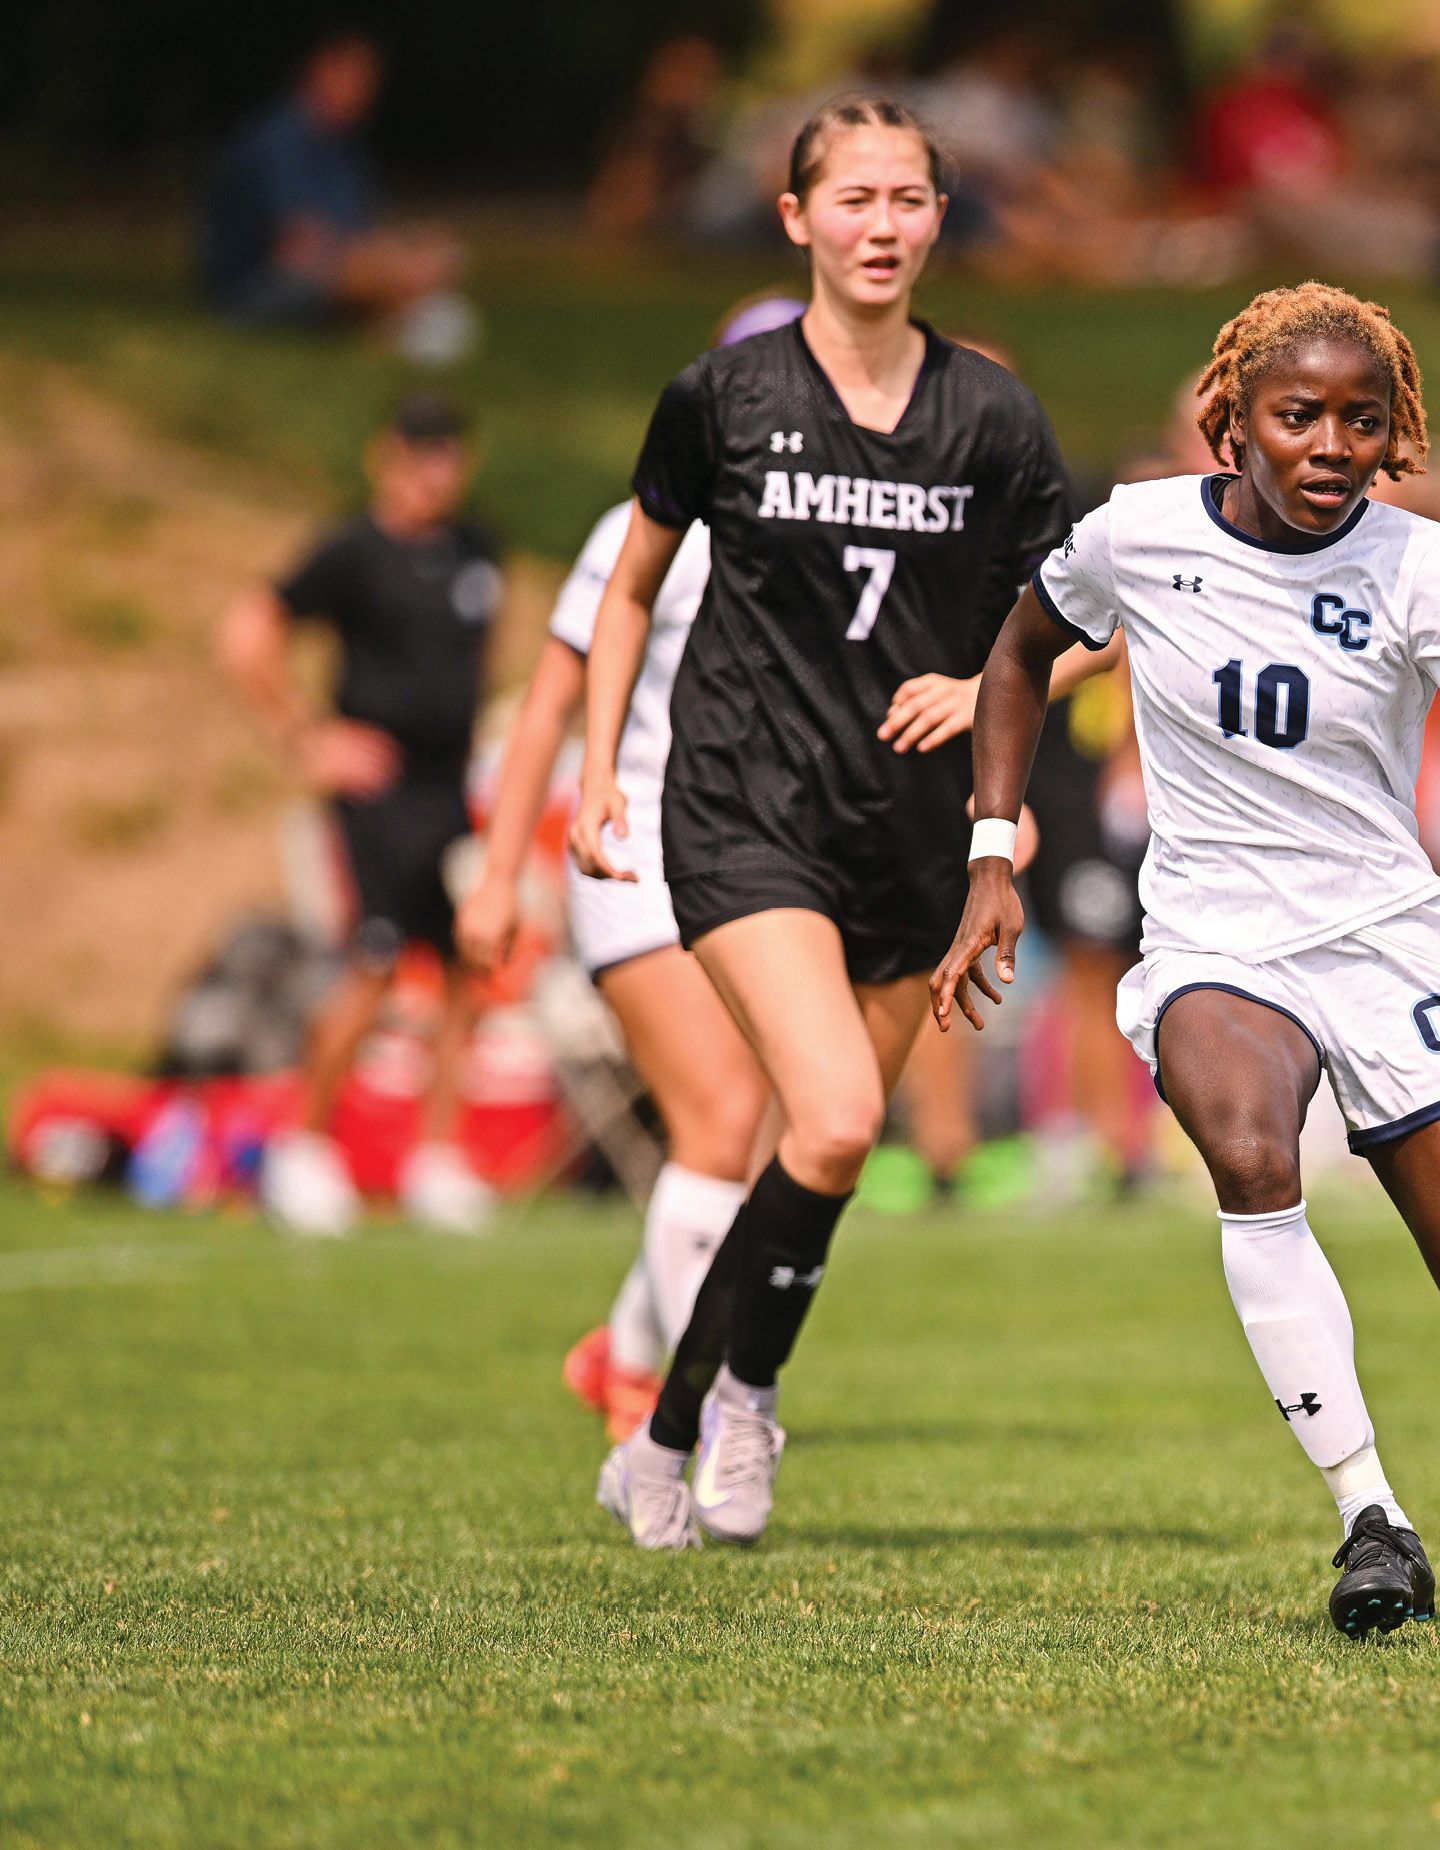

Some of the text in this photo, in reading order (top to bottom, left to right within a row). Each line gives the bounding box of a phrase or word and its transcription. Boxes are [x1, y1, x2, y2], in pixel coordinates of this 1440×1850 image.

[758, 471, 974, 533] AMHERST
[843, 545, 896, 640] 7
[1310, 592, 1372, 652] CC
[1211, 657, 1311, 750] 10
